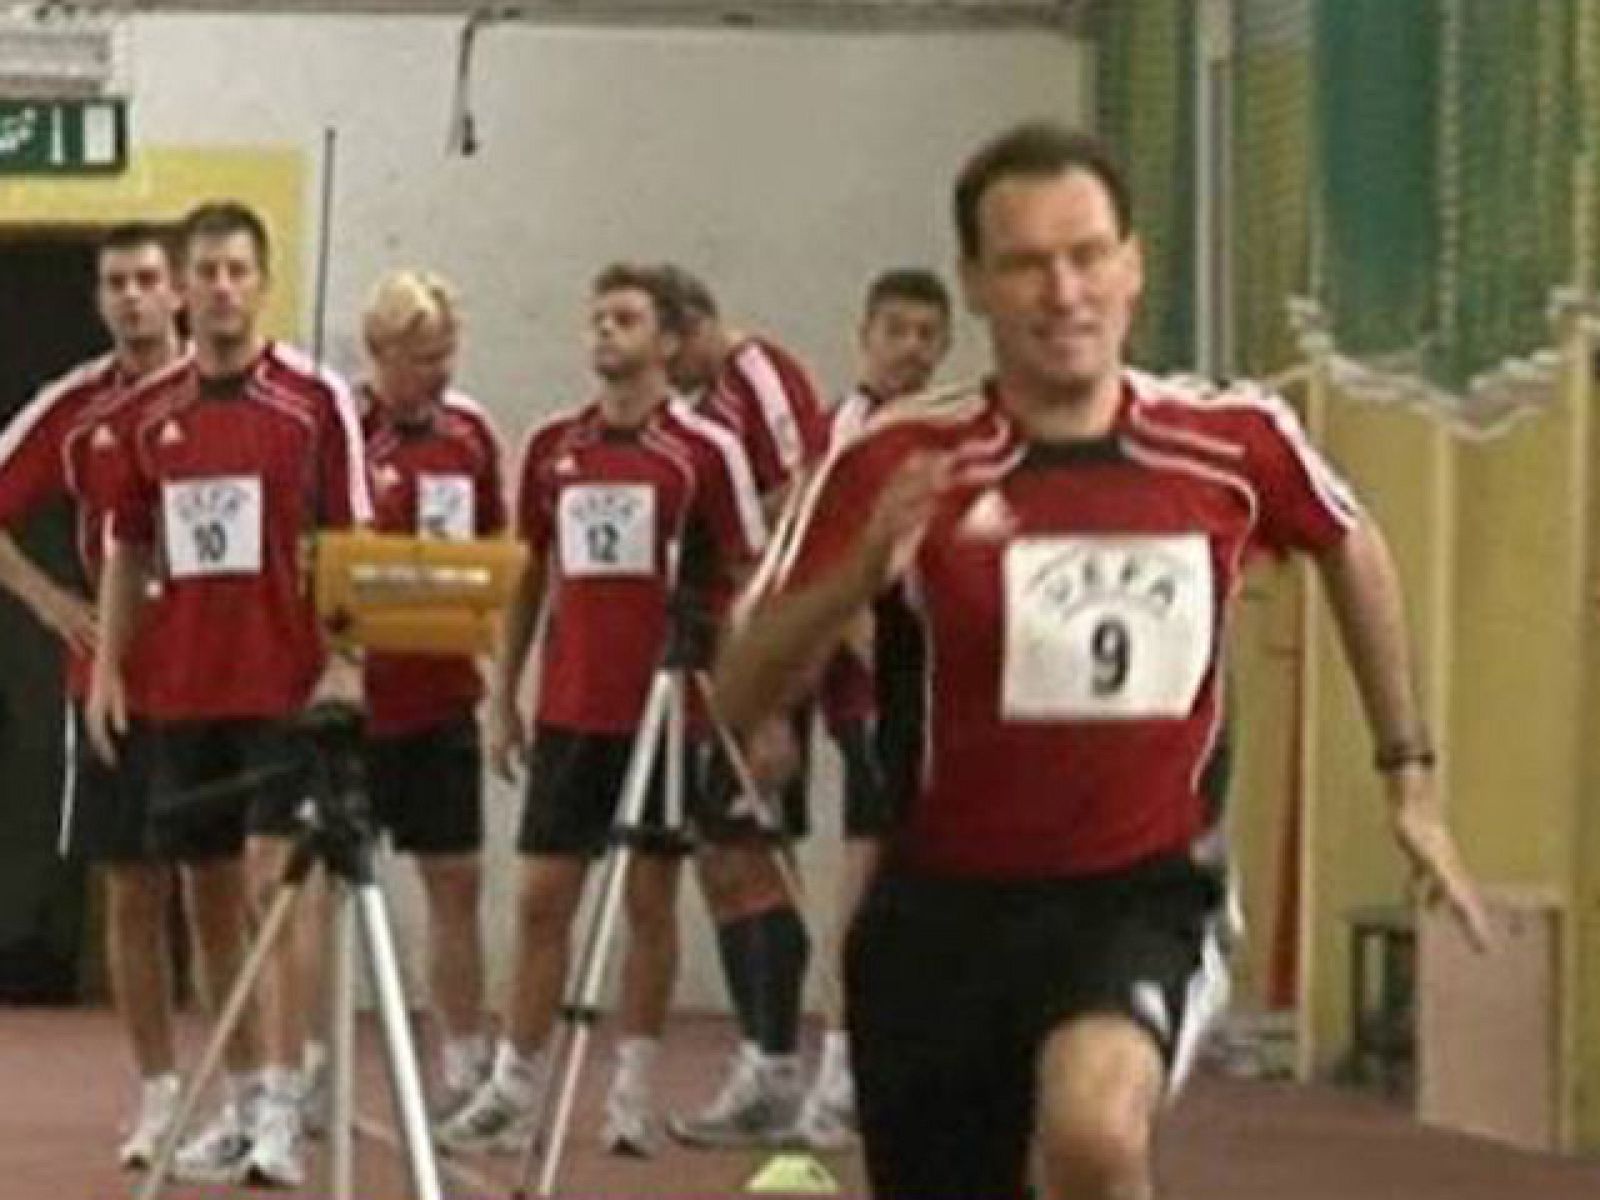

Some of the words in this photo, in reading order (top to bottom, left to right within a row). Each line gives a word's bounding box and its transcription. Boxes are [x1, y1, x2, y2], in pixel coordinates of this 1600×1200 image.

[193, 521, 227, 563] 10
[586, 522, 619, 563] 12
[1089, 617, 1130, 696] 9
